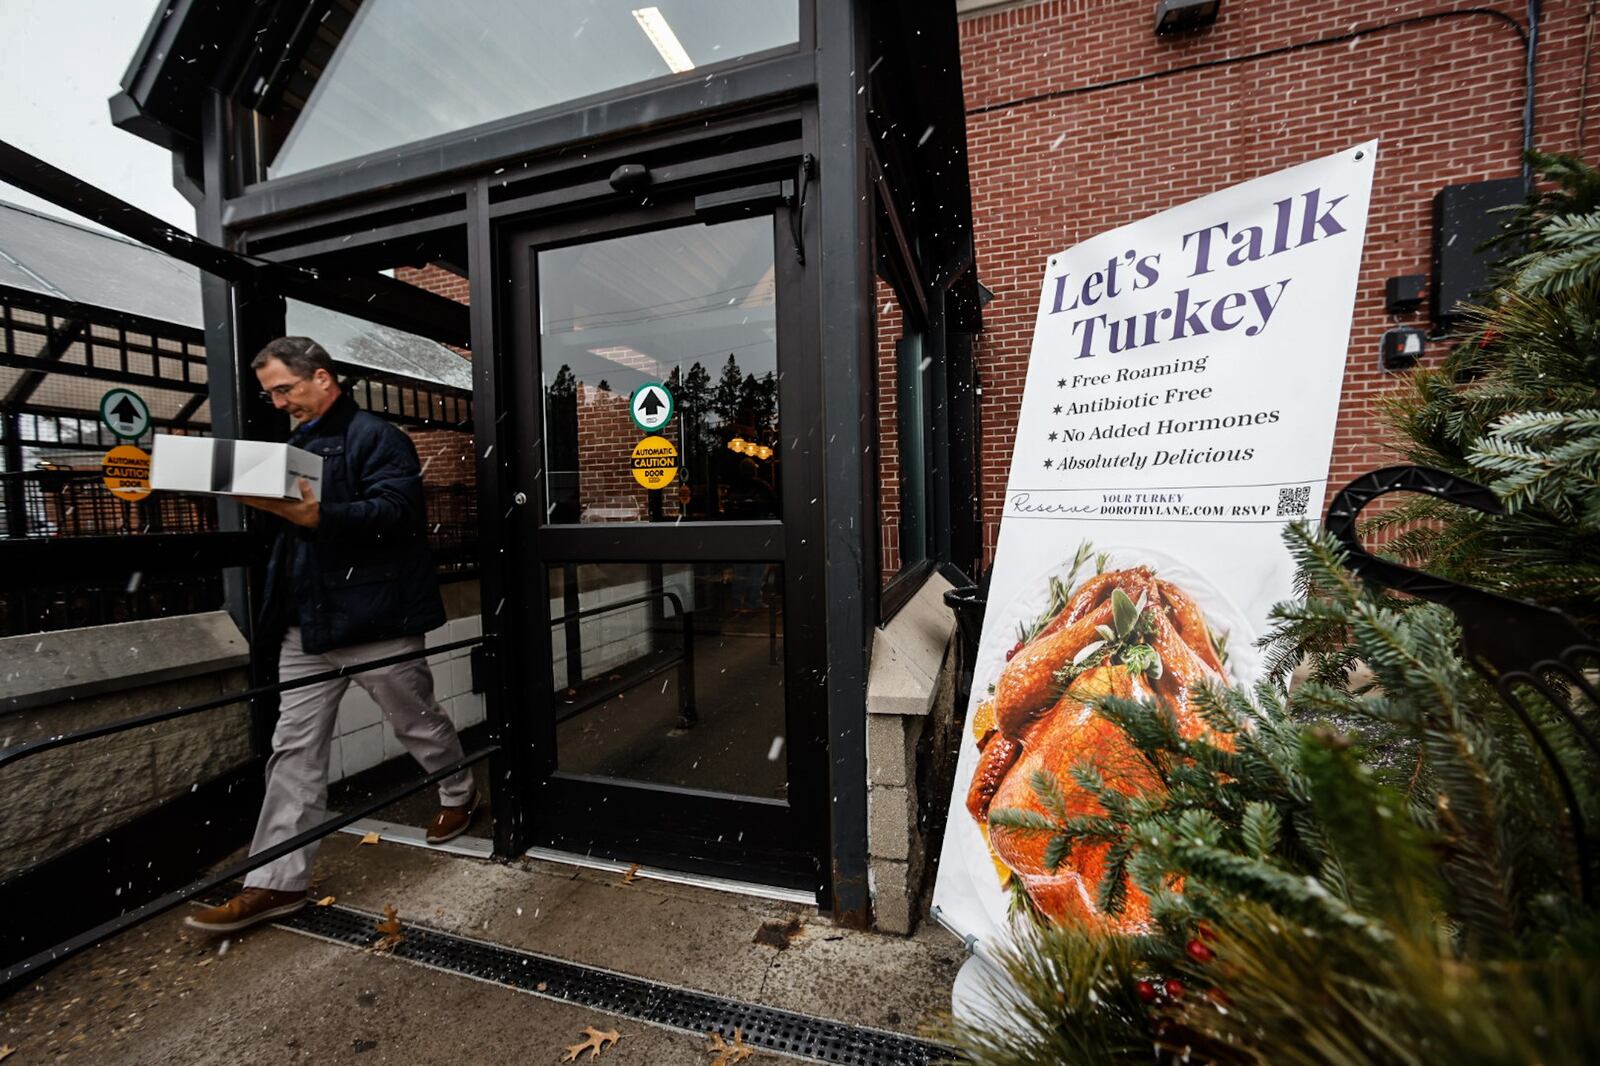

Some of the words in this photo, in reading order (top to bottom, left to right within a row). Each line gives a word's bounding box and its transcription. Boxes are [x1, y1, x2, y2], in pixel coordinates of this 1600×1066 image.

[1049, 249, 1162, 315] Let’s
[1181, 187, 1349, 278] Talk
[1072, 278, 1293, 361] Turkey
[1071, 371, 1111, 389] Free
[1116, 355, 1209, 382] Roaming
[1066, 392, 1159, 416] Antibiotic
[1165, 384, 1213, 404] Free
[1061, 428, 1085, 443] No
[1089, 421, 1150, 441] Added
[1157, 409, 1280, 436] Hormones
[634, 457, 675, 468] CAUTION
[636, 447, 673, 456] AUTOMATIC
[1057, 449, 1148, 471] Absolutely
[1153, 444, 1255, 466] Delicious
[1010, 492, 1099, 513] Reserve
[1102, 493, 1133, 504] YOUR
[1135, 492, 1185, 504] TURKEY
